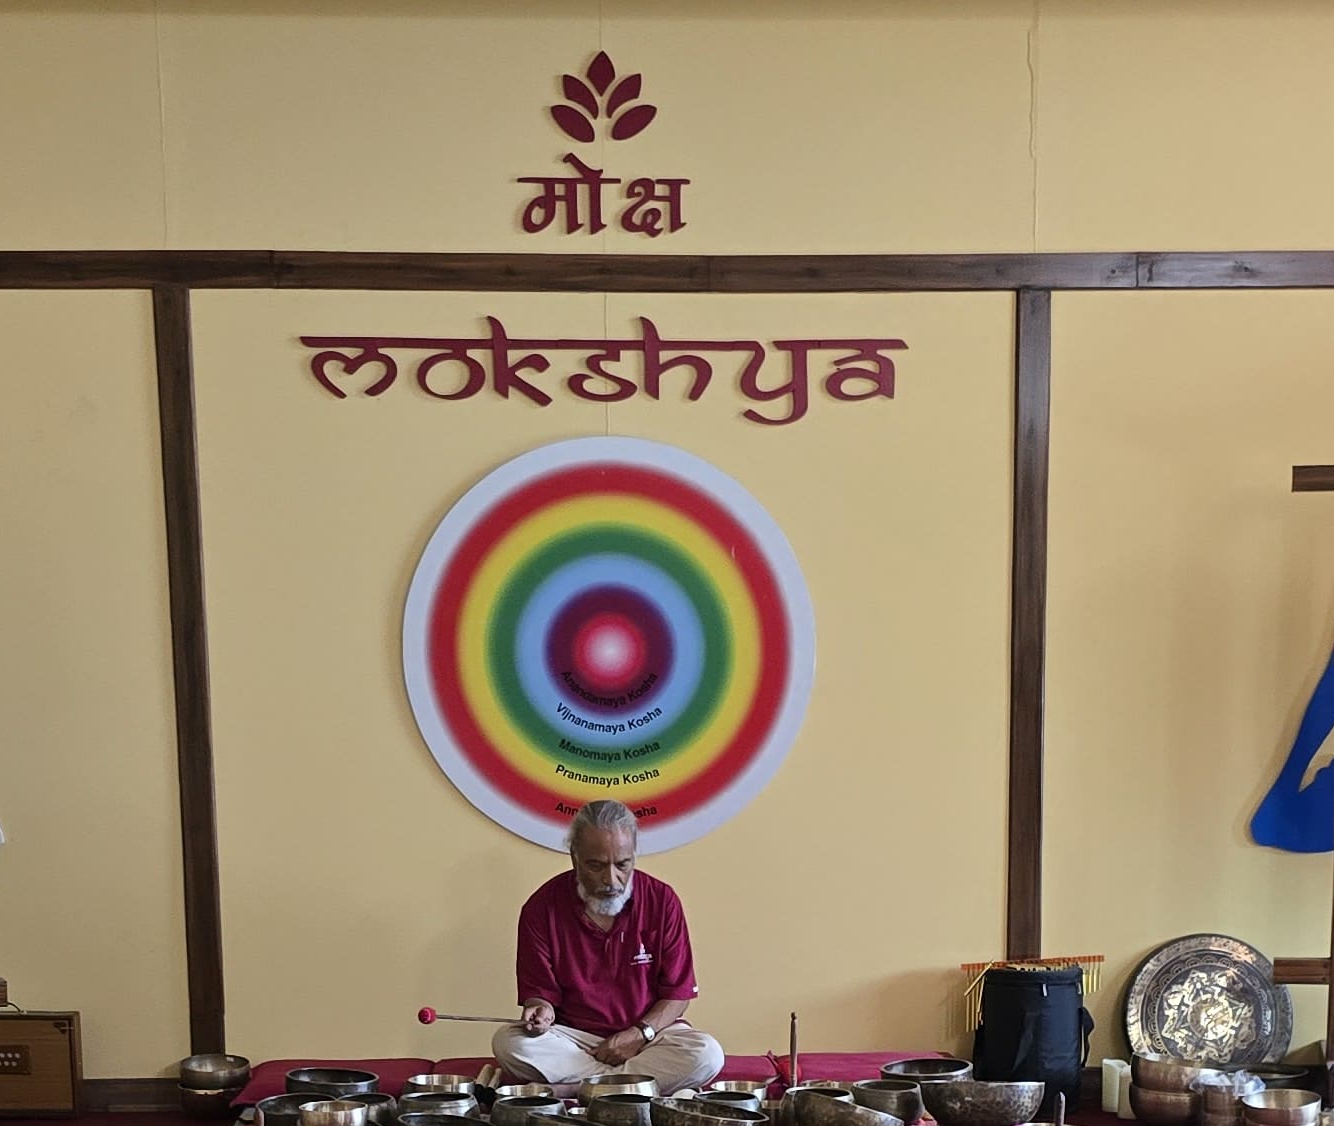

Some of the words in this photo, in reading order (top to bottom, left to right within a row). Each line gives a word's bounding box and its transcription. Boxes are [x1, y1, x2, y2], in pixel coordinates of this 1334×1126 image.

[517, 152, 691, 237] मोक्ष
[628, 673, 658, 701] Kosha
[556, 702, 626, 735] Vijnanamaya
[628, 707, 663, 730] Kosha
[558, 739, 621, 763] Manomaya
[623, 741, 660, 760] Kosha
[555, 764, 620, 788] Pranamaya
[623, 768, 660, 785] Kosha
